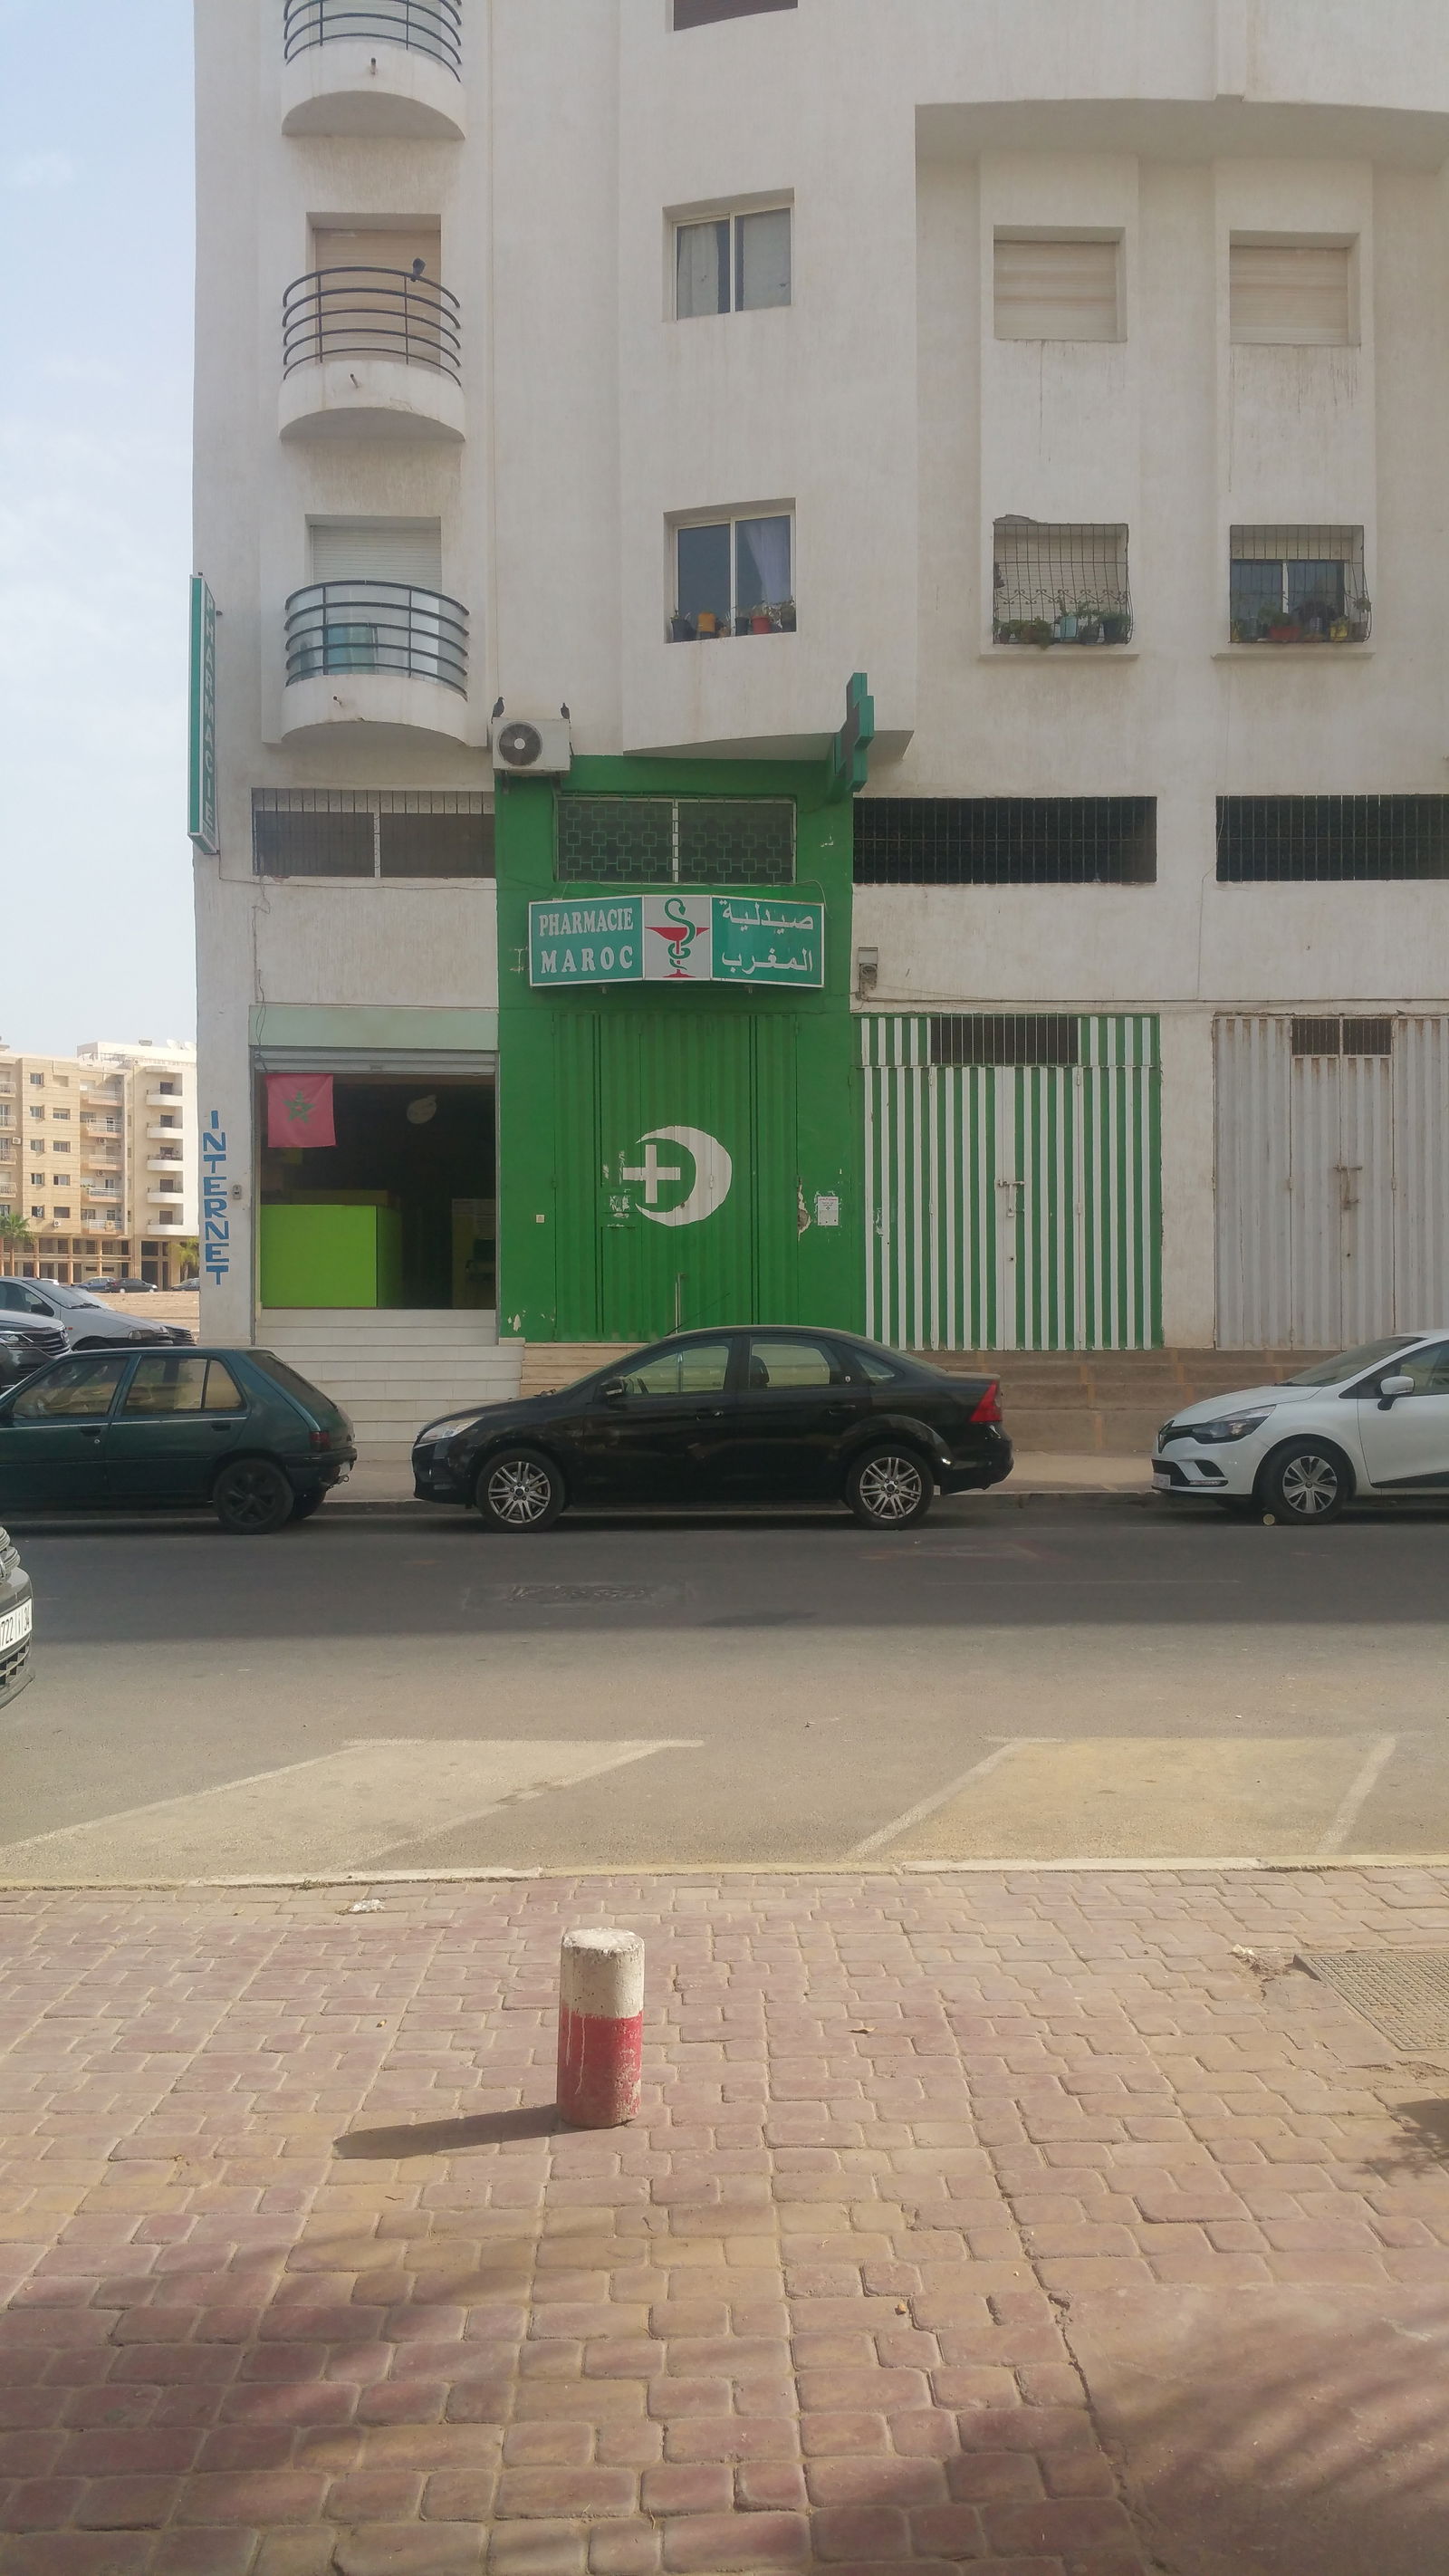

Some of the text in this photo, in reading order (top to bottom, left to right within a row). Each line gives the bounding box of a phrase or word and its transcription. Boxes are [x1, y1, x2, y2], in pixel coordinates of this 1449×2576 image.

[204, 590, 214, 827] PHARMACIE
[539, 908, 633, 937] PHARMACIE
[719, 899, 814, 935] صيدلية
[541, 946, 633, 974] MAROC
[722, 947, 813, 975] المغرب
[203, 1110, 229, 1285] INTERNET
[0, 1617, 14, 1647] 722
